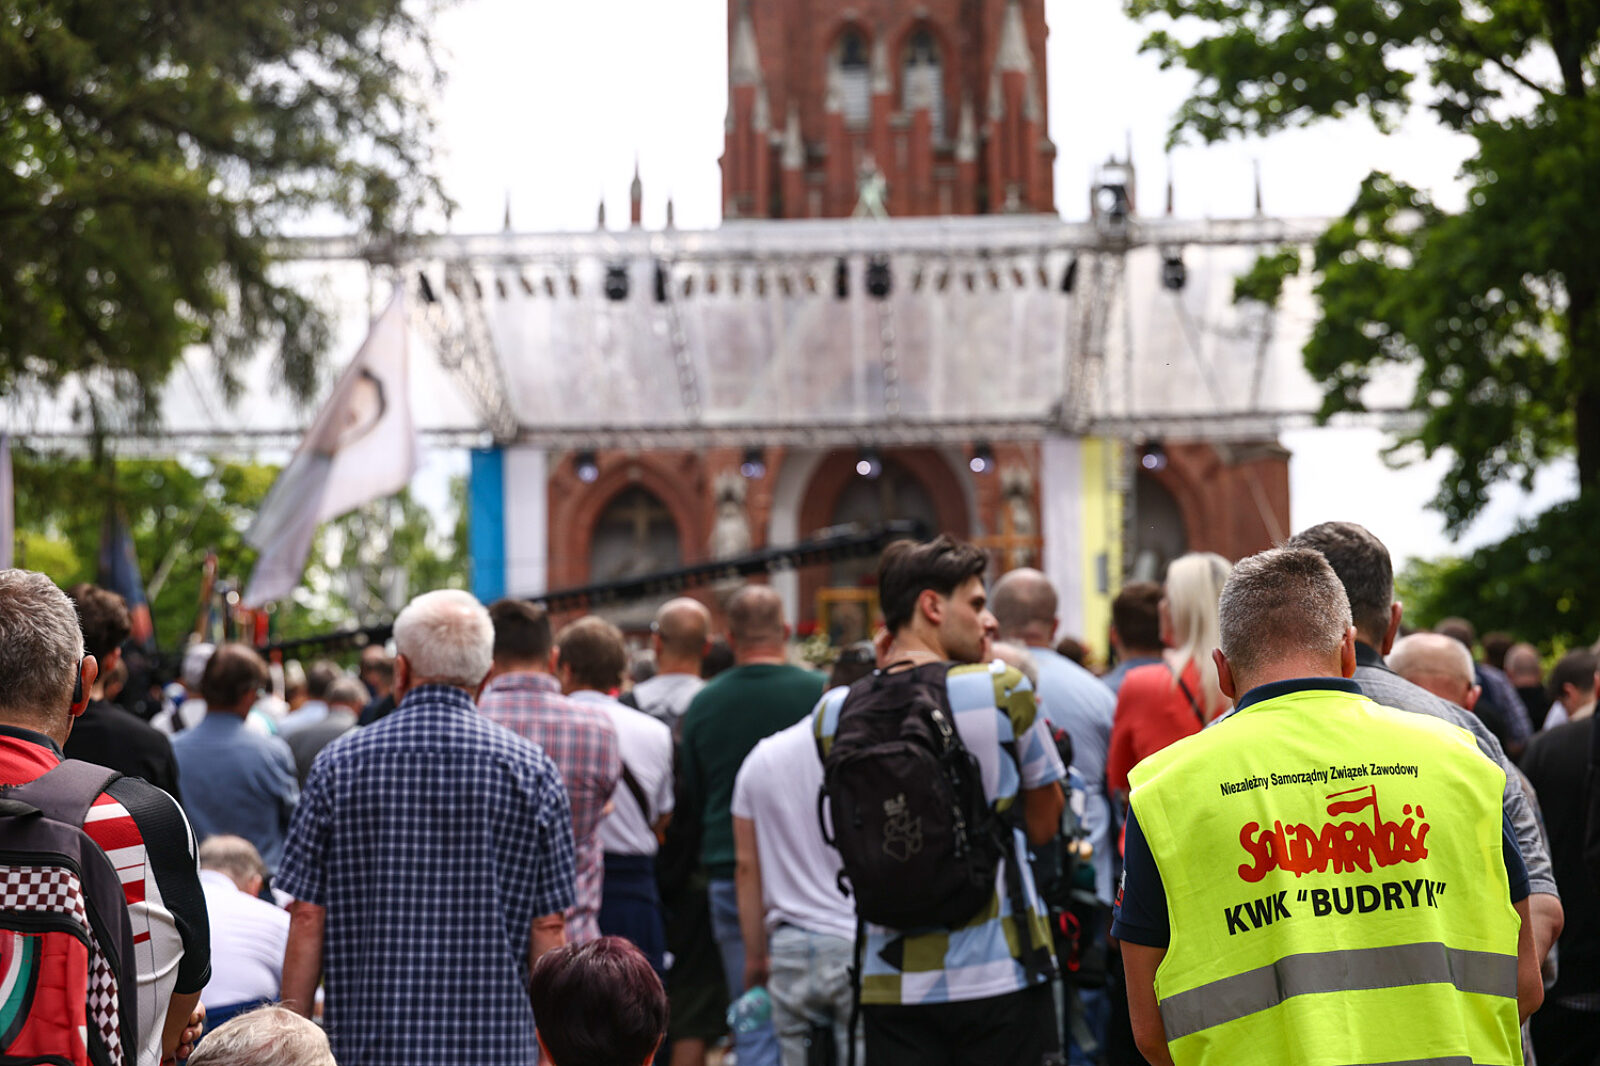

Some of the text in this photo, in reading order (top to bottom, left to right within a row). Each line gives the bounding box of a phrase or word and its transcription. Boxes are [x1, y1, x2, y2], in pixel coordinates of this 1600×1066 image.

[1220, 763, 1418, 796] Niezależny Samorządny Związek Zawodowy
[1224, 890, 1291, 936] KWK
